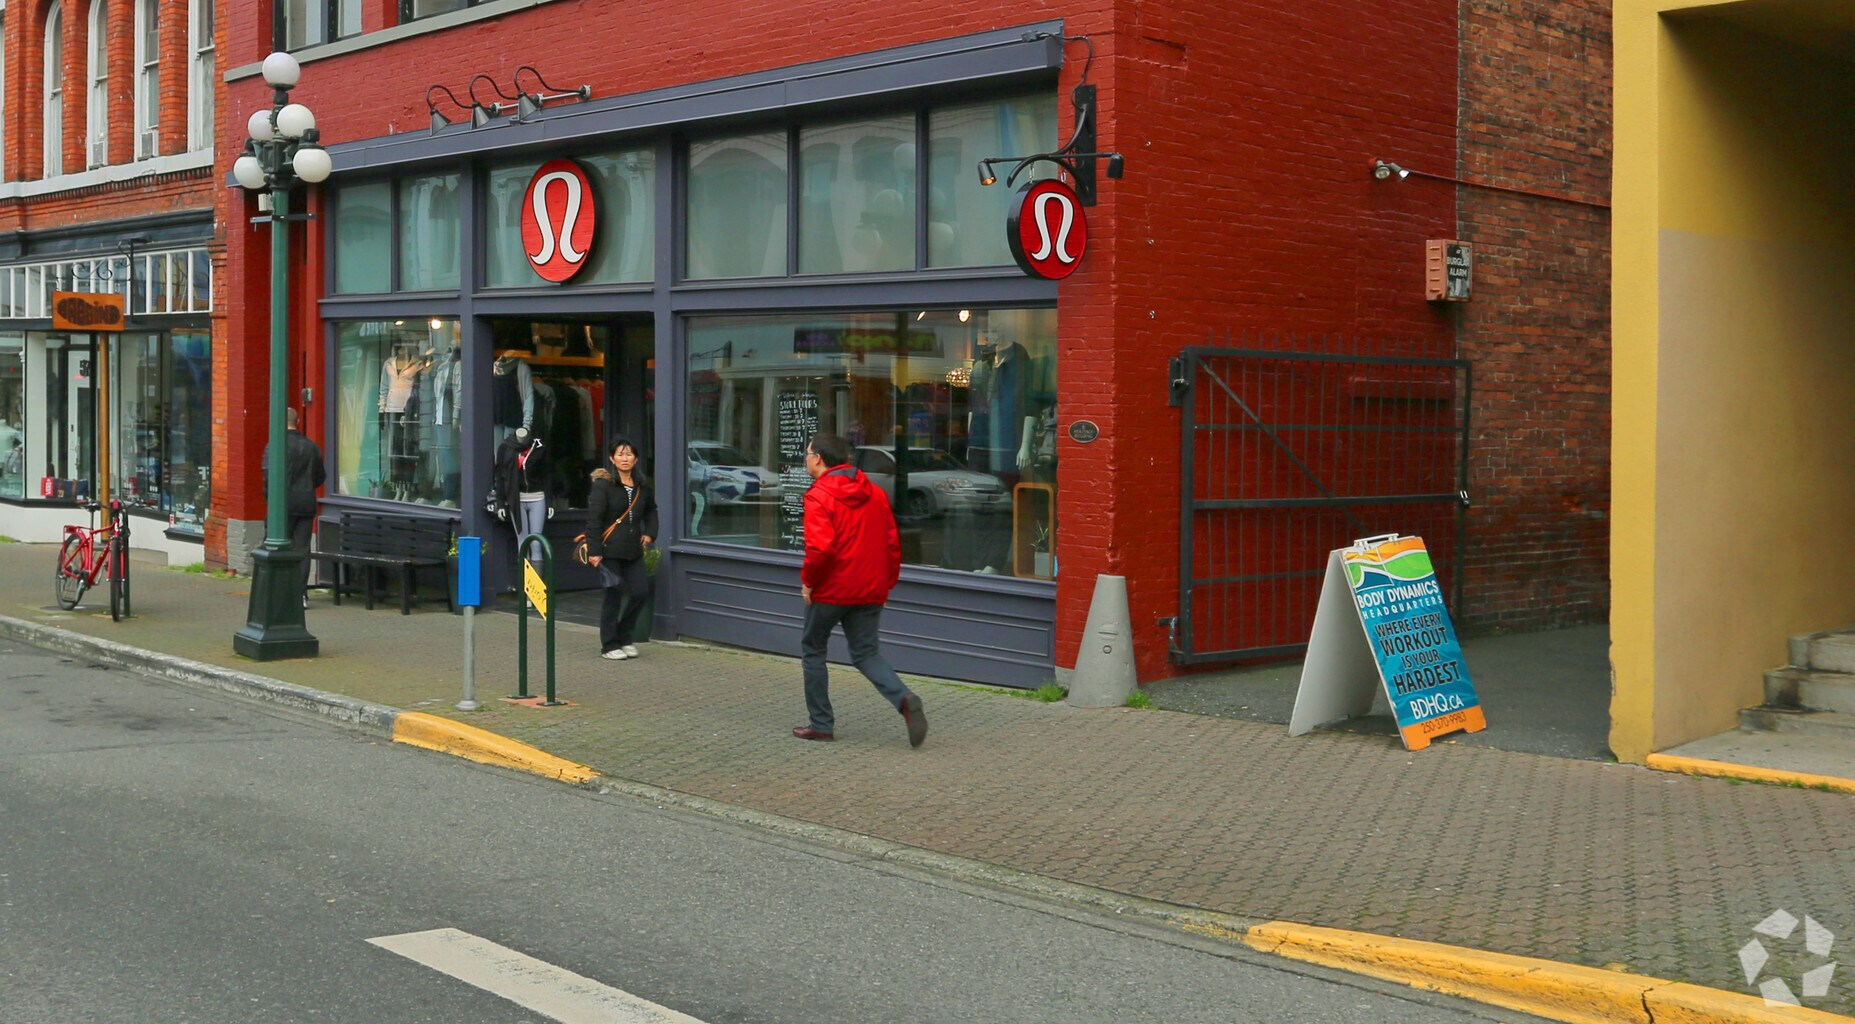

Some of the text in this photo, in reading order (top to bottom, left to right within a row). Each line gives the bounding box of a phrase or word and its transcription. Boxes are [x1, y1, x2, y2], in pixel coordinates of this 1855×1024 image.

[1447, 257, 1470, 267] BURGLAR
[1449, 267, 1467, 277] ALARM
[1357, 580, 1439, 608] BODY DYNAMICS
[1362, 595, 1443, 620] HEADQUARTERS
[1375, 612, 1442, 638] WHERE EVERY
[1380, 627, 1448, 657] WORKOUT
[1401, 649, 1441, 669] IS YOUR
[1393, 661, 1460, 695] HARDEST
[1409, 692, 1465, 720] BDHQ.CA
[1420, 711, 1467, 734] 250-370-9983
